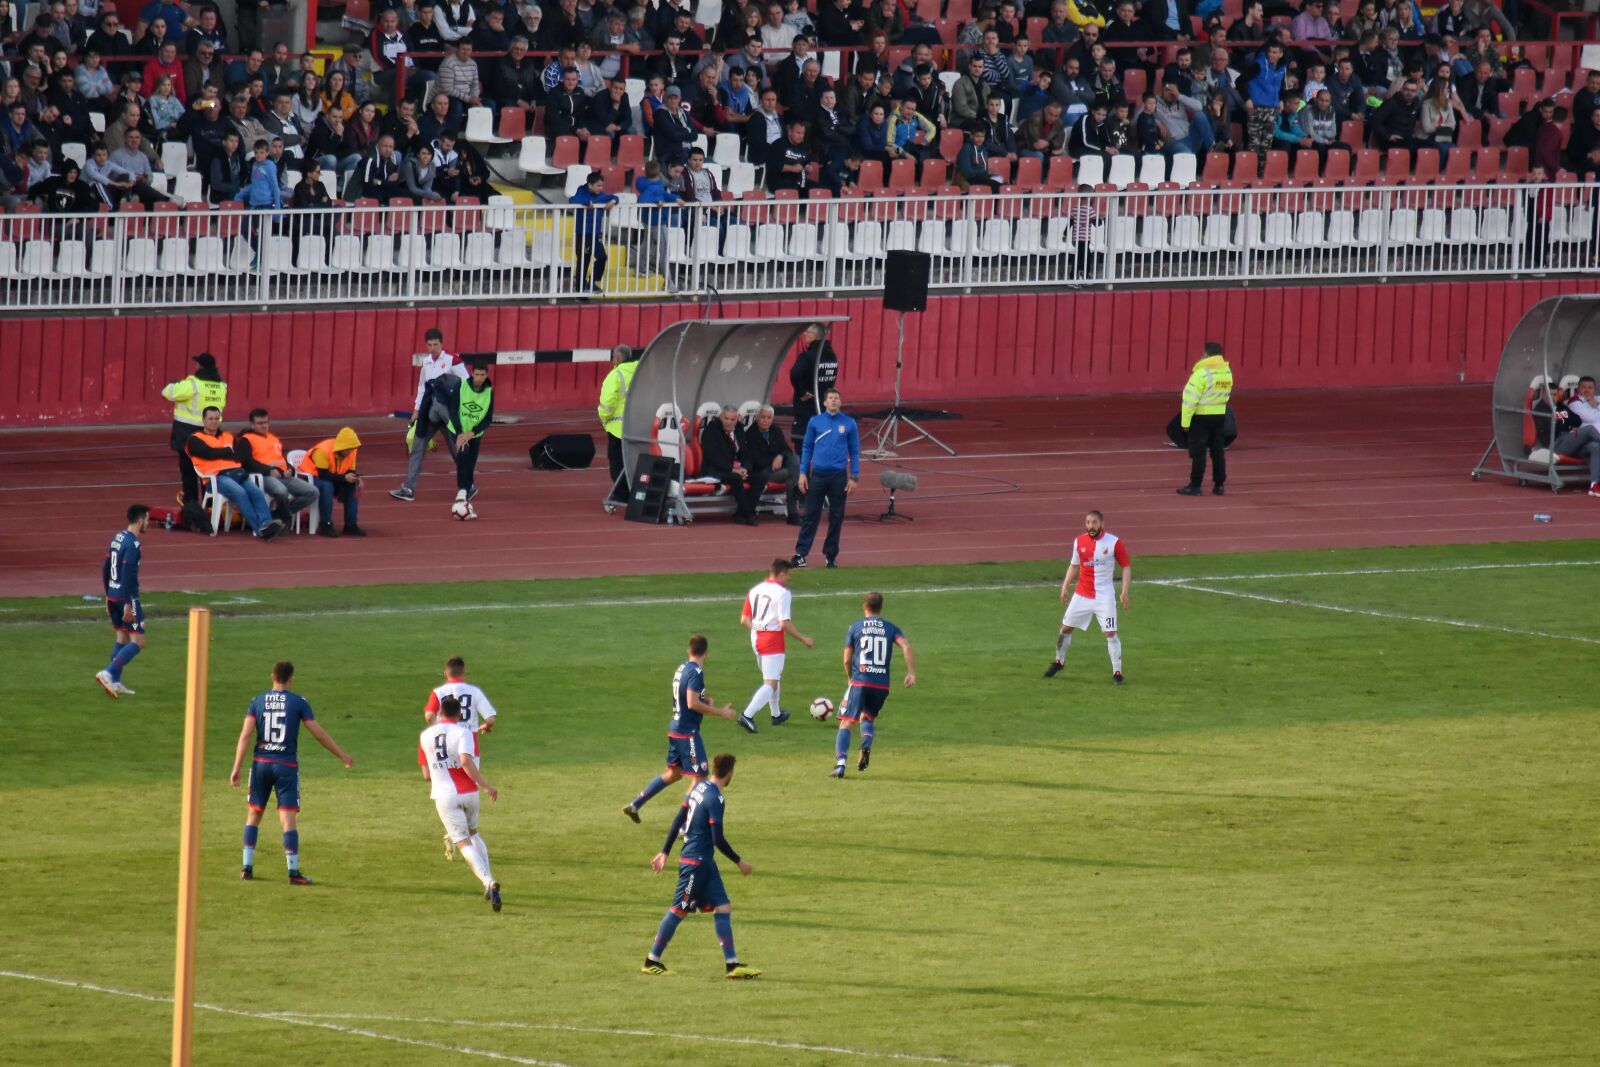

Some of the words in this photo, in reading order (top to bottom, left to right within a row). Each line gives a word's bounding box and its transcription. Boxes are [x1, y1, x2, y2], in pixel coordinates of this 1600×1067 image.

[461, 411, 480, 420] umbro
[752, 594, 772, 621] 17
[863, 619, 883, 628] mts
[1106, 617, 1115, 629] 31
[859, 636, 887, 666] 20
[265, 693, 286, 702] mts
[262, 712, 286, 743] 15
[434, 733, 449, 761] 9
